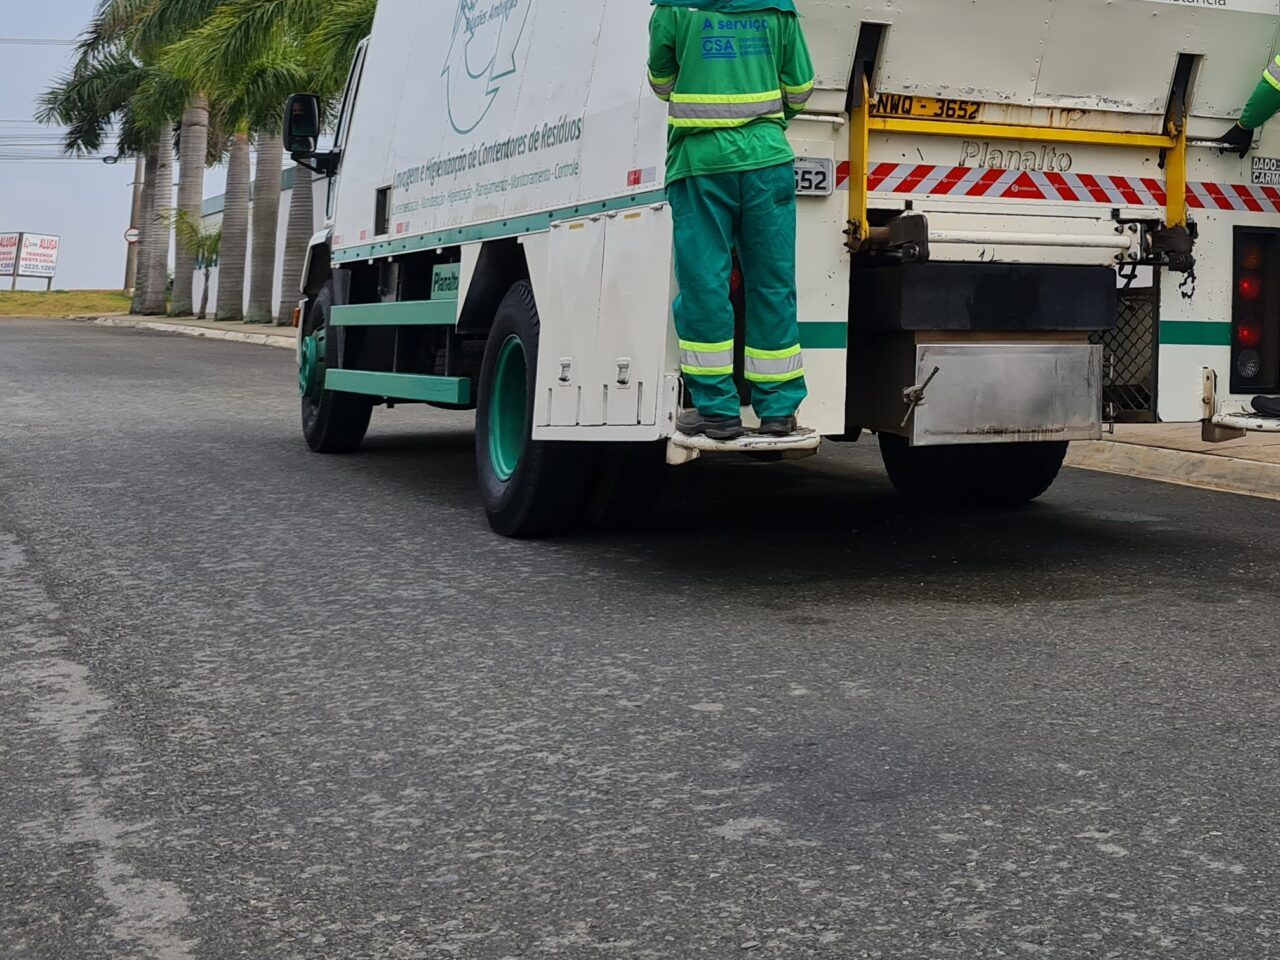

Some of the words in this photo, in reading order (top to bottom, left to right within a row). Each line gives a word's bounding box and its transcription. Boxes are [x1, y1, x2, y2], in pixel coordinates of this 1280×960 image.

[702, 18, 714, 31] A
[717, 16, 769, 32] serviço
[702, 39, 735, 53] CSA
[876, 93, 914, 116] NWQ
[933, 98, 981, 120] 3652
[425, 147, 467, 187] Higienização
[467, 145, 478, 170] de
[477, 133, 528, 167] Contentores
[527, 128, 540, 152] de
[540, 115, 582, 151] Resíduos
[958, 140, 1074, 173] Planalto
[554, 157, 579, 181] Controle
[1252, 157, 1277, 171] DADO
[433, 271, 459, 292] Planalto
